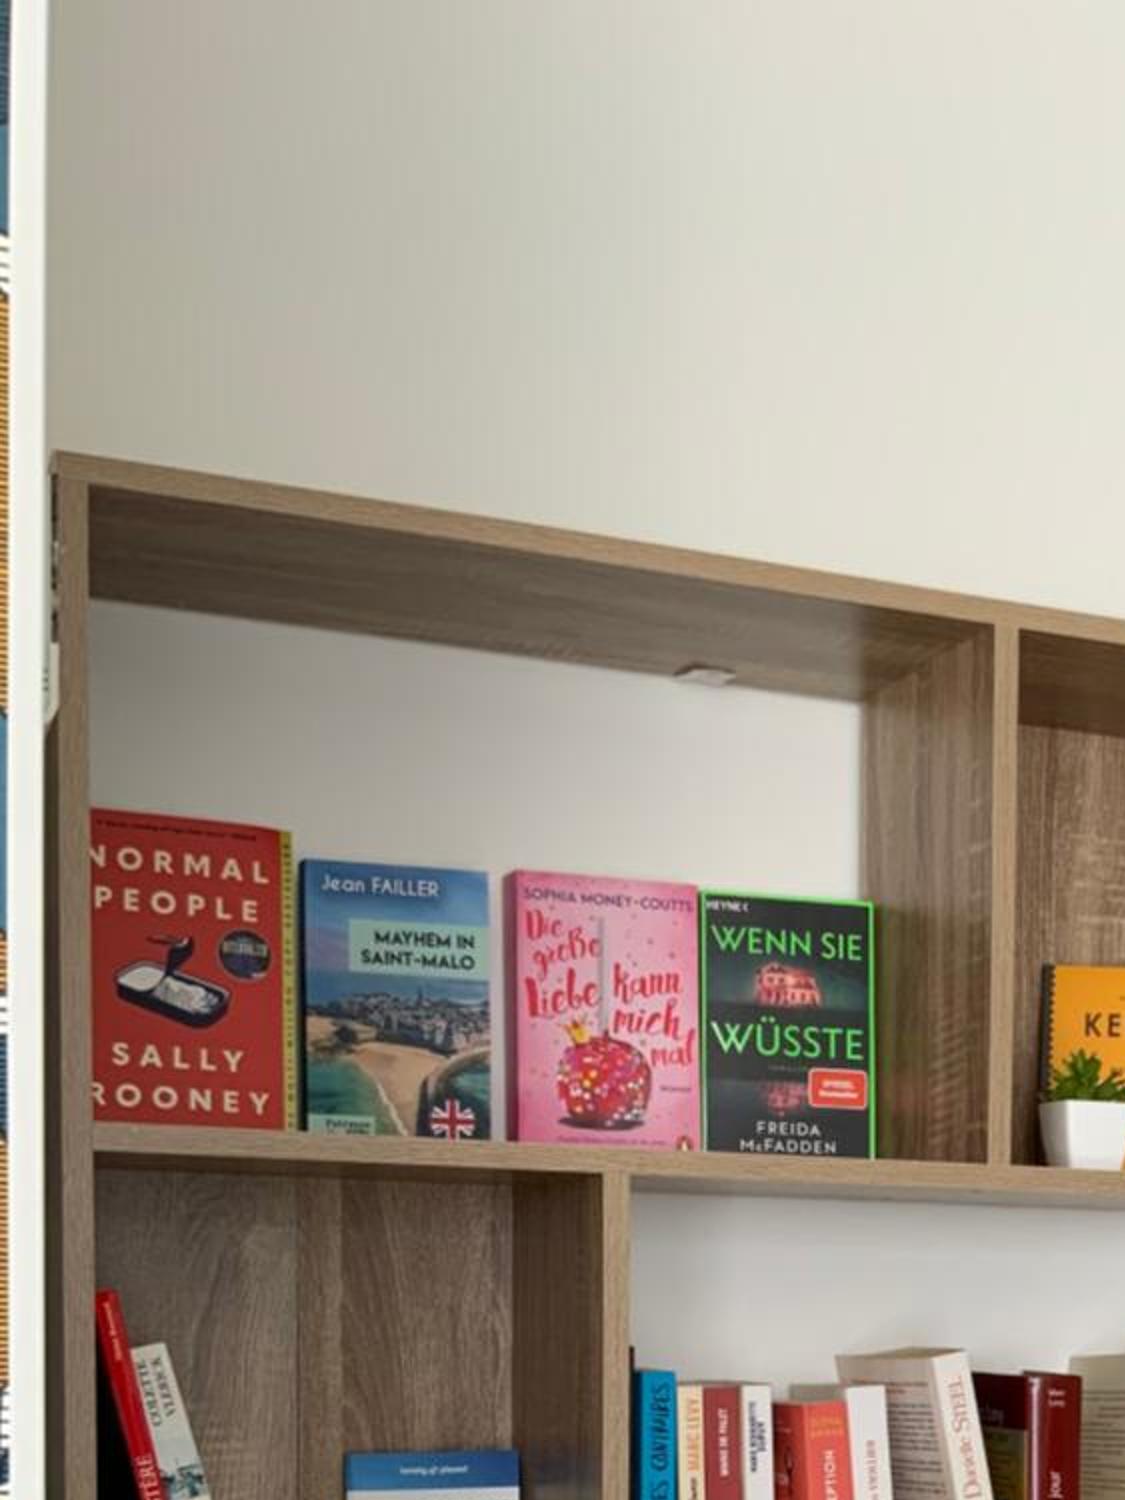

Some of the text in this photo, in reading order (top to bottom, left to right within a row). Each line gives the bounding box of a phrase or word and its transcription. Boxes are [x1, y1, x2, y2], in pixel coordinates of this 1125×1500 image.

[88, 845, 270, 885] NORMAL
[94, 885, 260, 923] PEOPLE
[320, 874, 440, 898] Jean FAILLER
[523, 886, 577, 903] SOPHIA
[373, 930, 476, 950] MAYHEM IN
[525, 910, 562, 941] Die
[711, 923, 863, 962] WENN SIE
[360, 948, 476, 971] SAINT-MALO
[532, 926, 601, 975] große
[524, 967, 598, 1019] Liebe
[612, 961, 684, 1002] kann
[612, 997, 684, 1041] mich
[111, 1041, 245, 1072] SALLY
[649, 1028, 696, 1068] mal
[711, 1015, 865, 1062] WÜSSTE
[92, 1082, 270, 1115] ROONEY
[739, 1137, 838, 1156] McFADDEN
[756, 1120, 821, 1138] FREIDA
[136, 1357, 163, 1428] COLETTE
[949, 1374, 984, 1500] Danielle STEEL
[1046, 1471, 1063, 1499] jour
